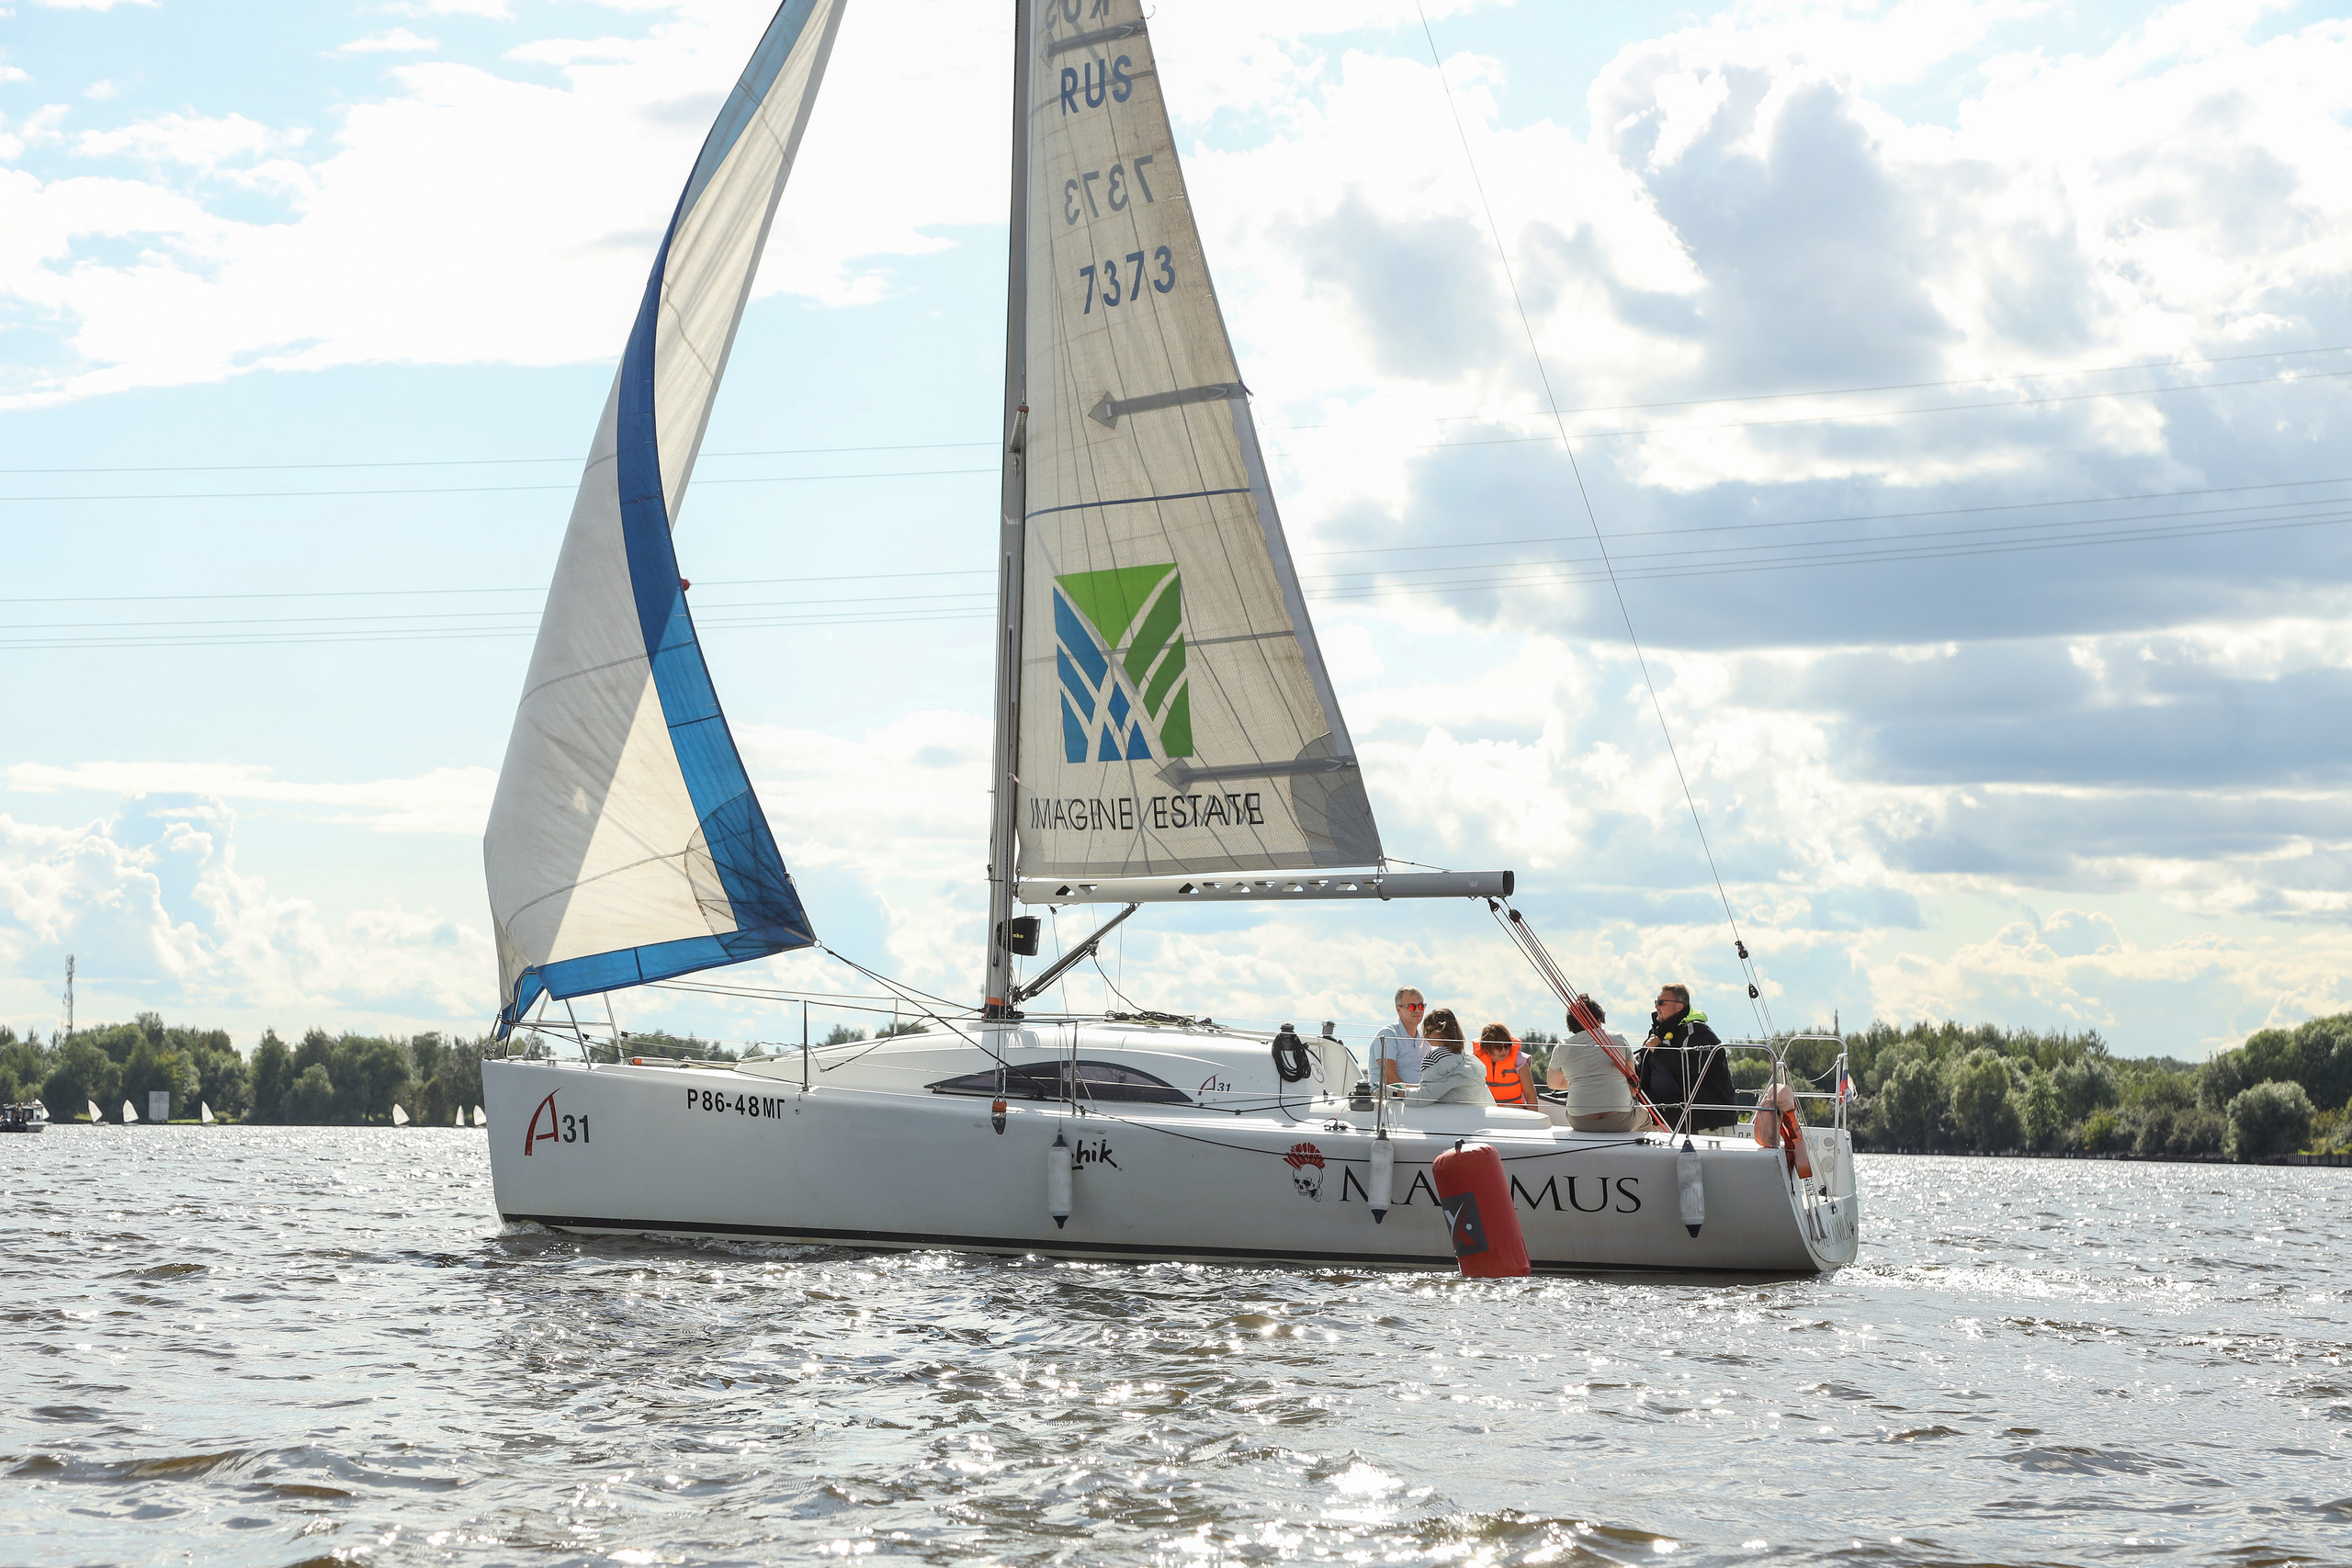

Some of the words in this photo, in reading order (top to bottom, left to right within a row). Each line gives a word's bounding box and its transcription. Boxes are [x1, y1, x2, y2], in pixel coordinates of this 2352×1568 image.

[1060, 54, 1133, 117] RUS
[1080, 244, 1176, 315] 7373
[1030, 796, 1134, 831] IMAGINE
[1153, 792, 1264, 829] ESTATE
[1070, 1138, 1118, 1171] hik
